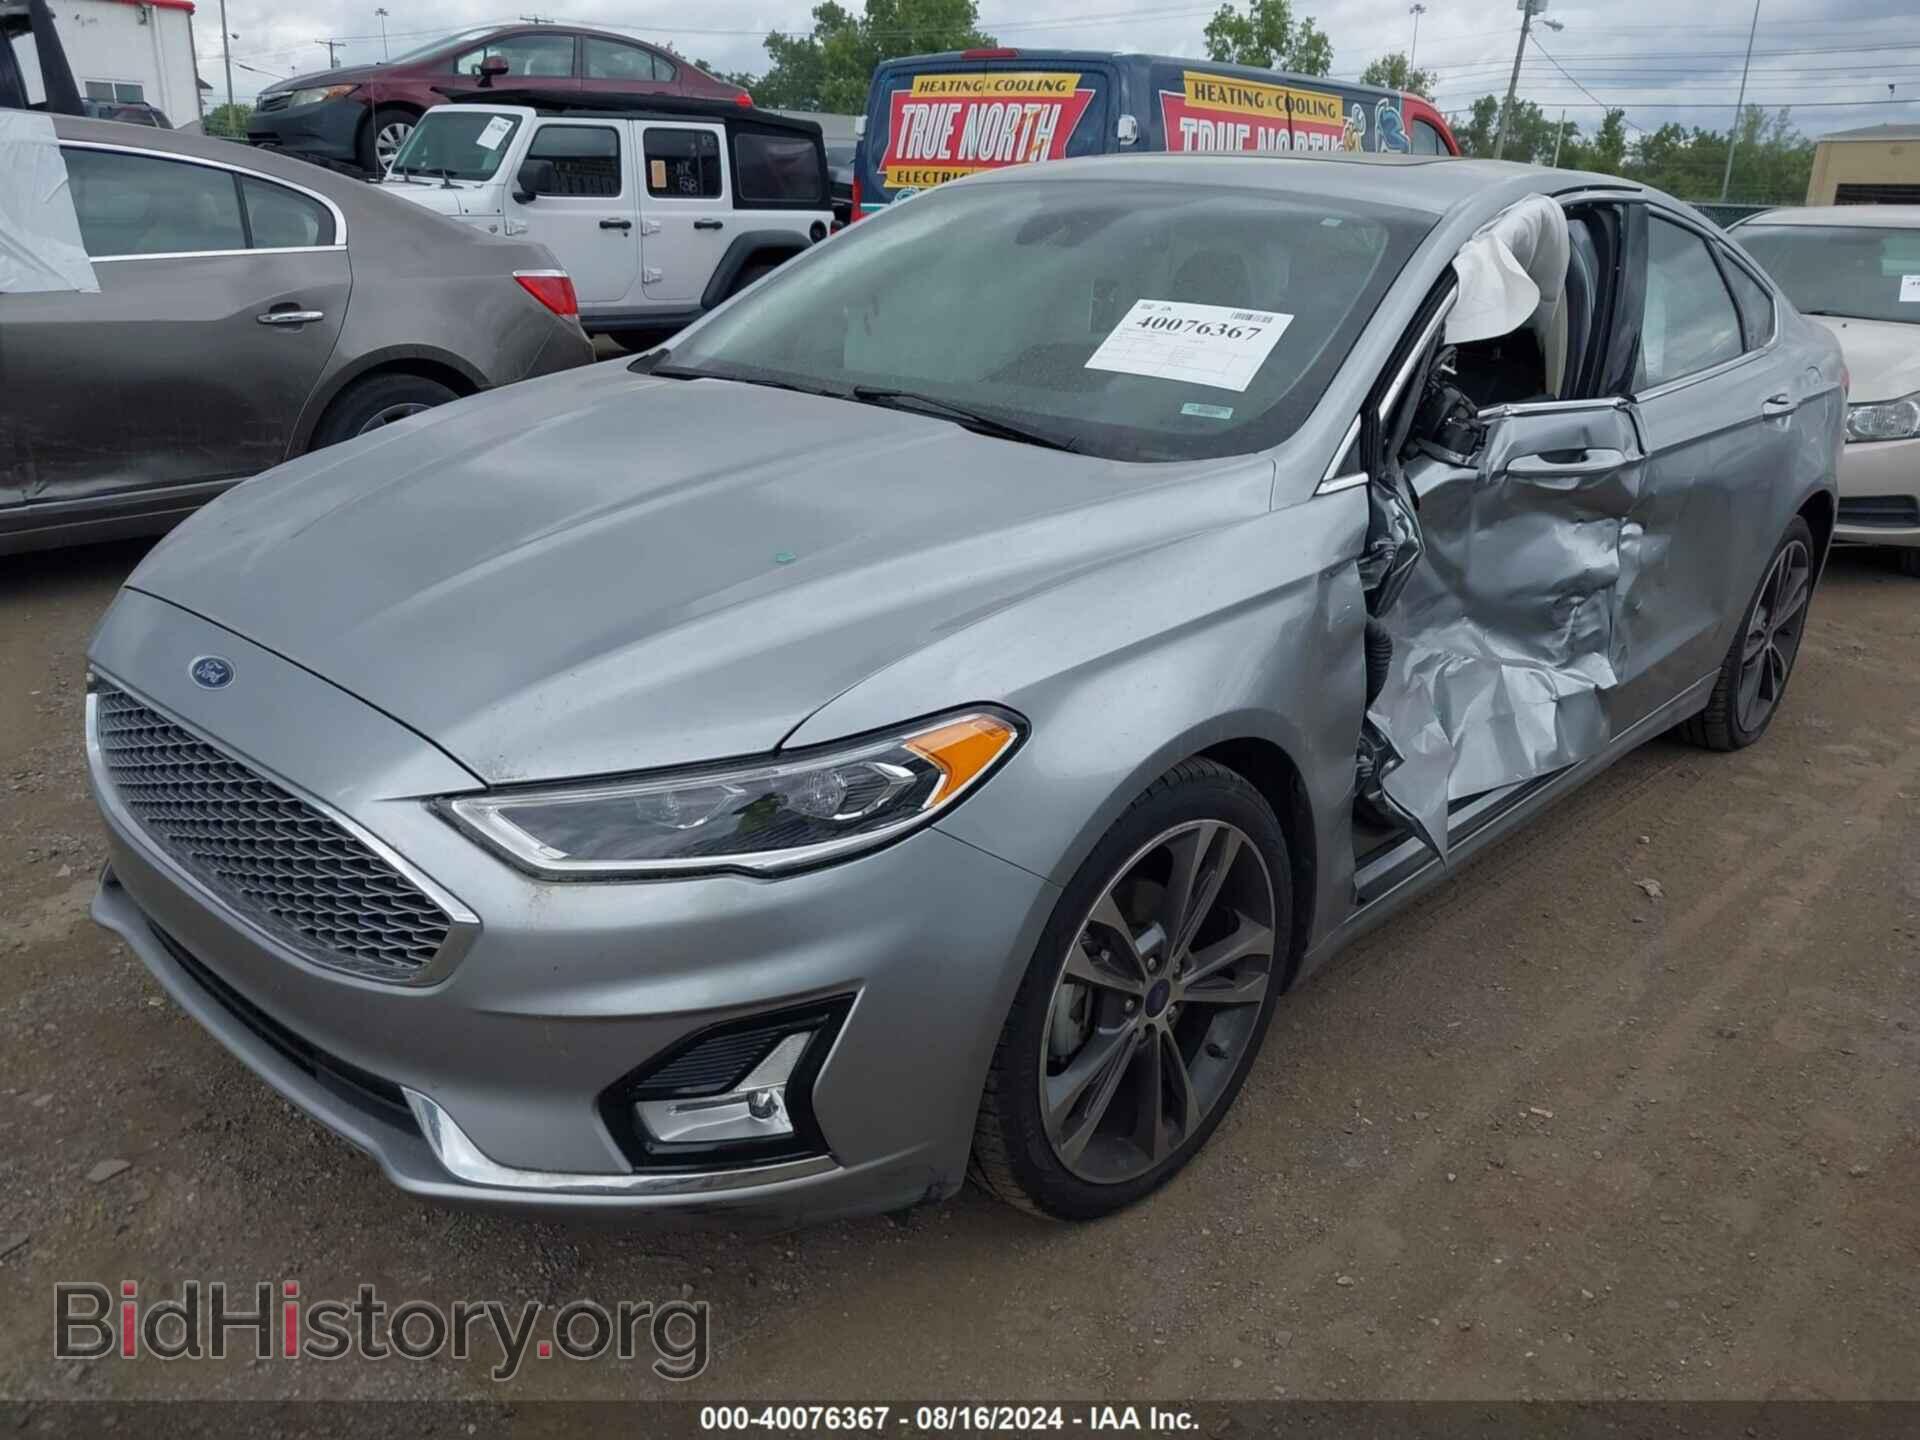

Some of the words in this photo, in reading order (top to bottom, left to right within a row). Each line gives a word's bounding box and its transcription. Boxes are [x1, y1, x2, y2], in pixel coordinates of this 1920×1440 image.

[918, 80, 982, 92] HEATING
[994, 79, 1066, 92] COOLING
[1194, 82, 1265, 109] HEATING
[1275, 94, 1337, 119] COOLING
[896, 103, 962, 160] TRUE
[957, 103, 1062, 162] NORTH
[1136, 316, 1262, 341] 40076367
